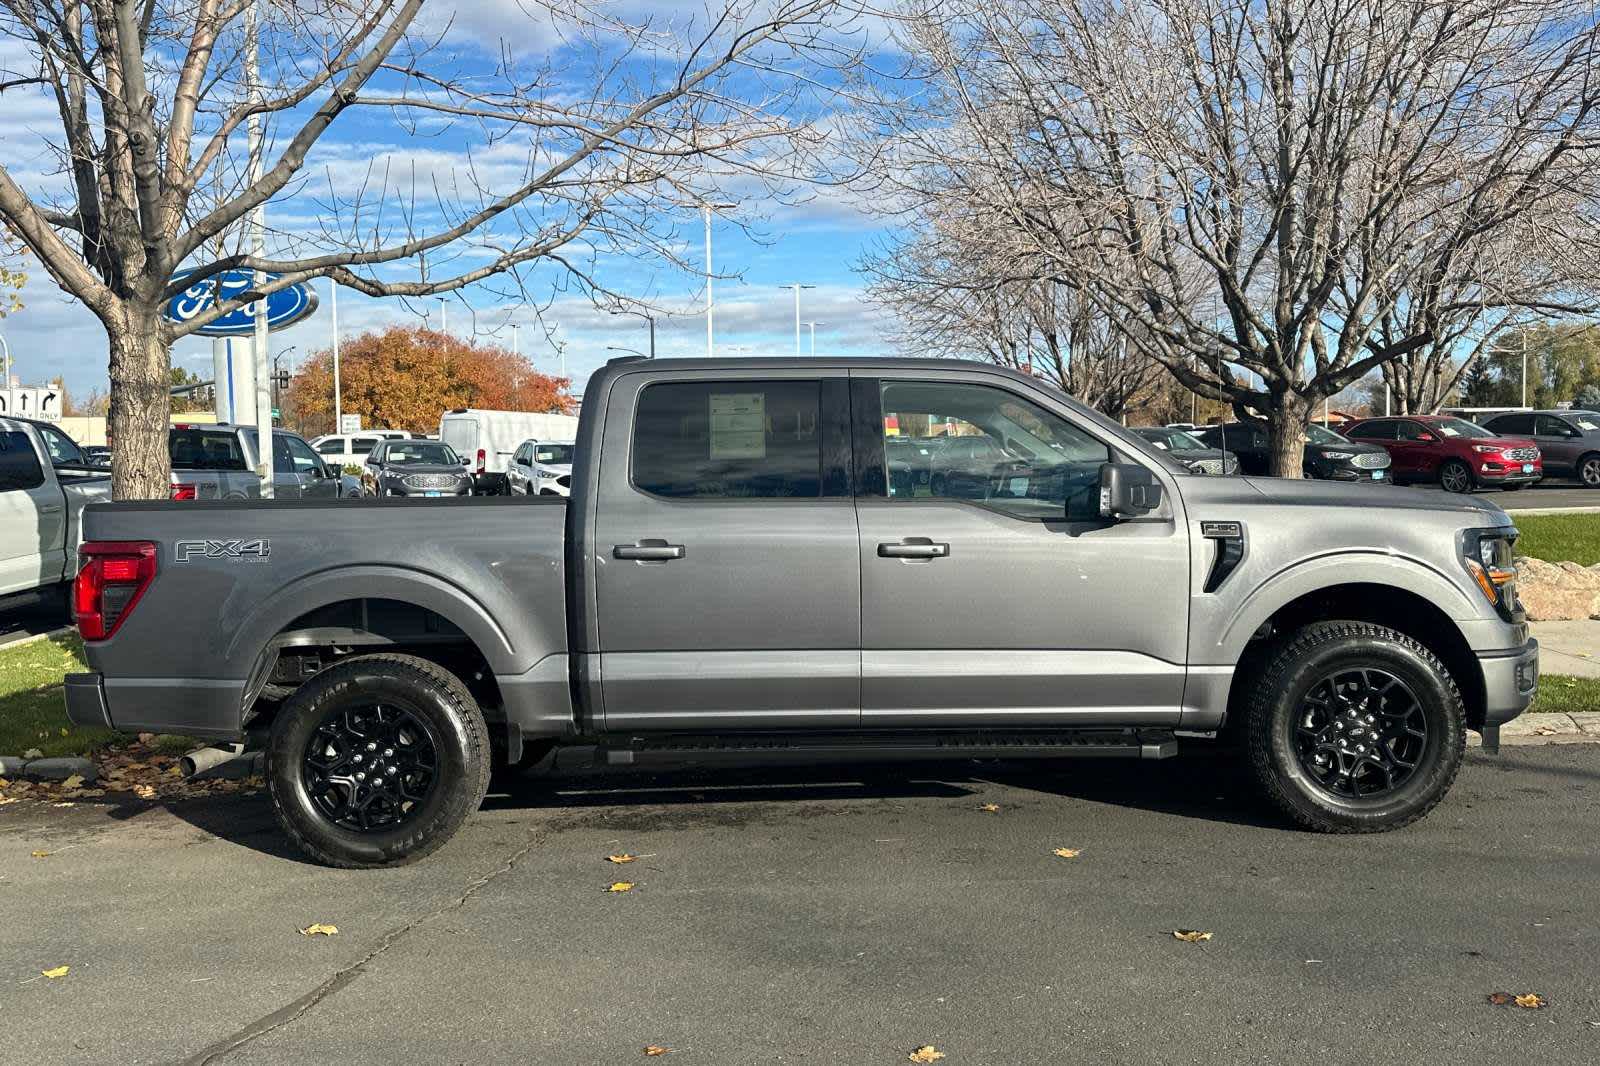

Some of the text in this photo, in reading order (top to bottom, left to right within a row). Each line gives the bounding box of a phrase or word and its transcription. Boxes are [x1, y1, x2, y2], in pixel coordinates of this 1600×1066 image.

[40, 412, 58, 420] ONLY
[1205, 524, 1238, 533] F-150
[175, 539, 271, 564] FX4
